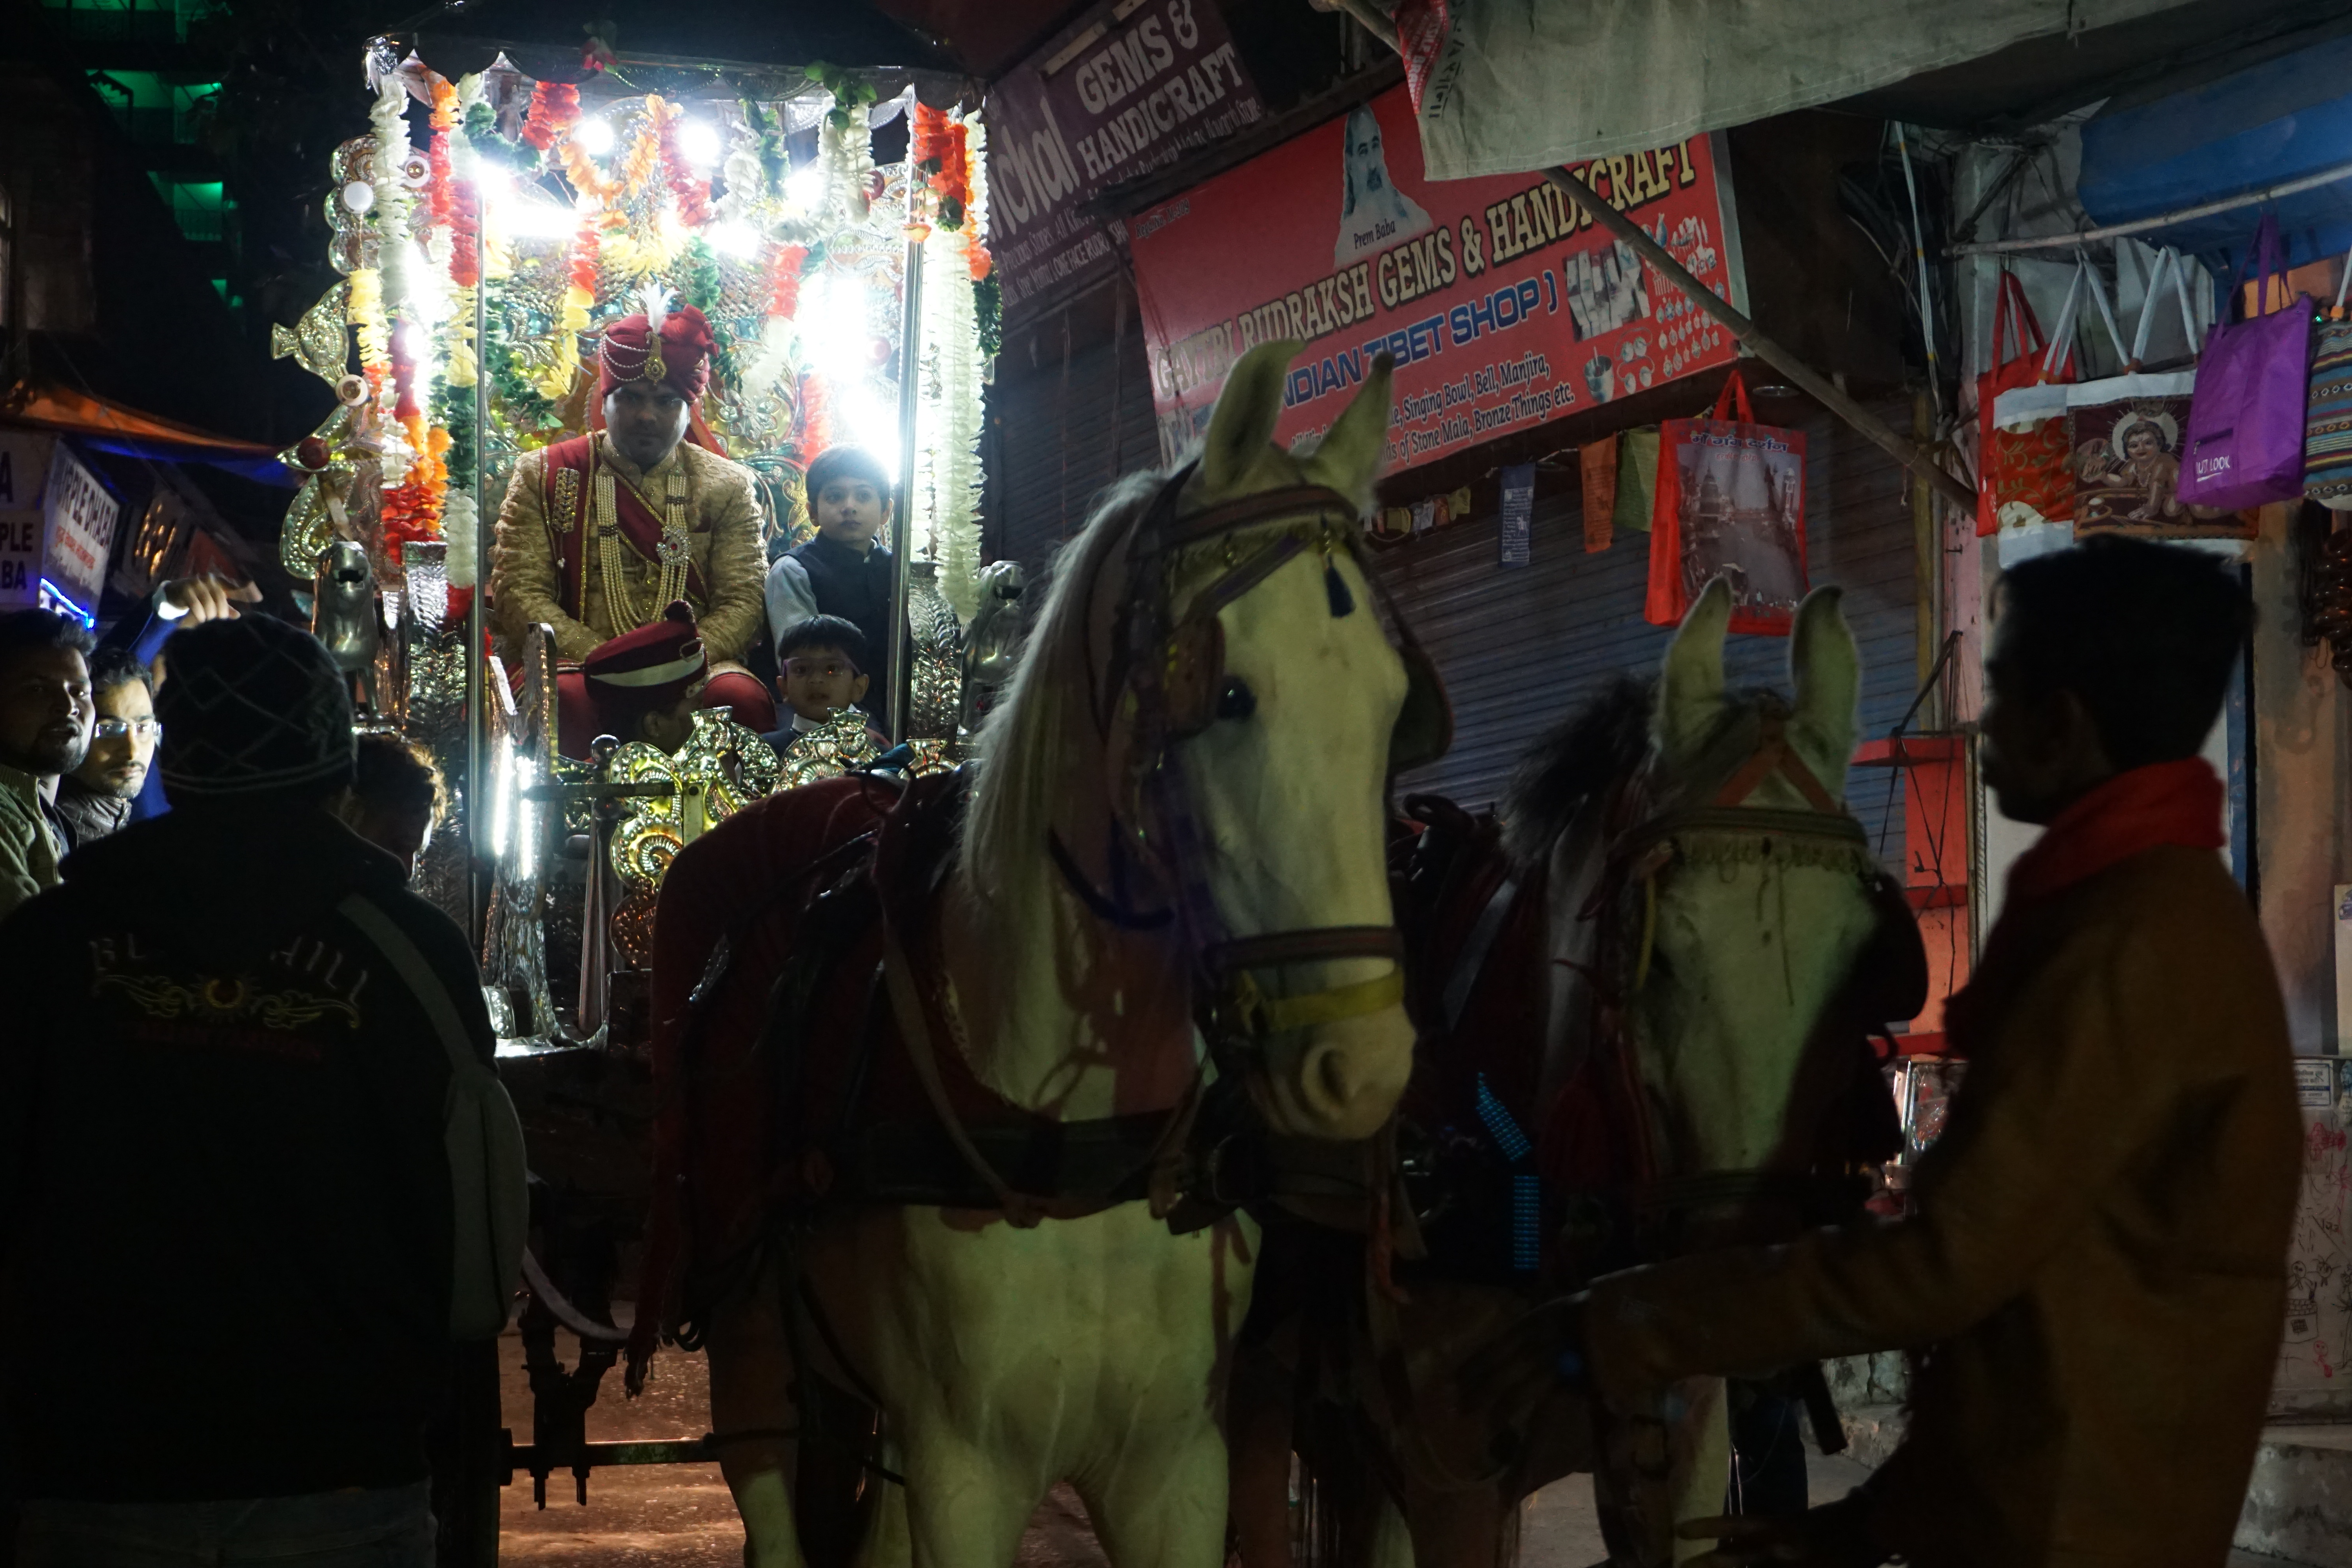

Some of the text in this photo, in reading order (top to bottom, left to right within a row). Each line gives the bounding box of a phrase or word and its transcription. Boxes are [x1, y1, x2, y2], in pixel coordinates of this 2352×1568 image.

[1076, 0, 1198, 114] GEMS &
[1077, 42, 1243, 180] HANDICRAFT
[1354, 218, 1396, 250] Prem Baba
[1238, 261, 1375, 352] RUDRAKSH
[1377, 225, 1456, 310] GEMS
[1460, 216, 1485, 278] &
[1282, 346, 1363, 408] NDIAN
[1449, 277, 1541, 346] SHOP
[1400, 432, 1410, 463] of
[1412, 428, 1440, 454] Stone
[1441, 414, 1473, 443] Mala,
[1474, 405, 1511, 432] Bronze
[1512, 390, 1552, 420] Things
[1554, 383, 1575, 406] etc.
[1403, 390, 1443, 423] Singing
[1443, 374, 1474, 407] Bowl,
[1475, 365, 1499, 395] Bell,
[1500, 354, 1550, 387] Manjira,
[2210, 455, 2230, 471] LOOK
[0, 560, 26, 589] BA
